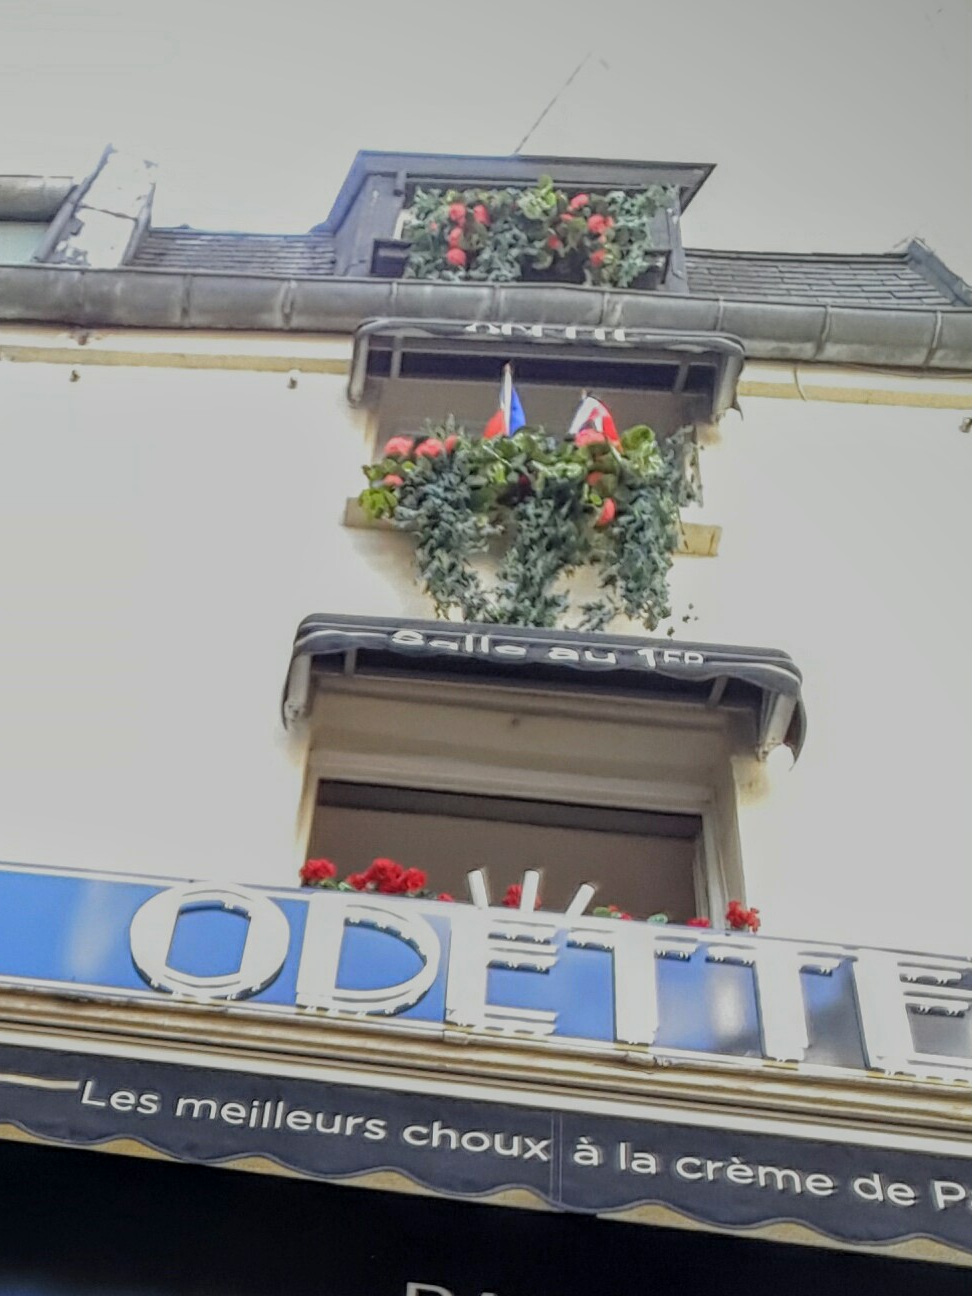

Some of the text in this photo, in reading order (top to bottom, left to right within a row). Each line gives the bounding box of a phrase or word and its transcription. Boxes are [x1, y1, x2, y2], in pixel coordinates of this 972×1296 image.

[129, 880, 972, 1084] ODETTE
[79, 1079, 972, 1210] Les meilleurs choux à la crème de P
